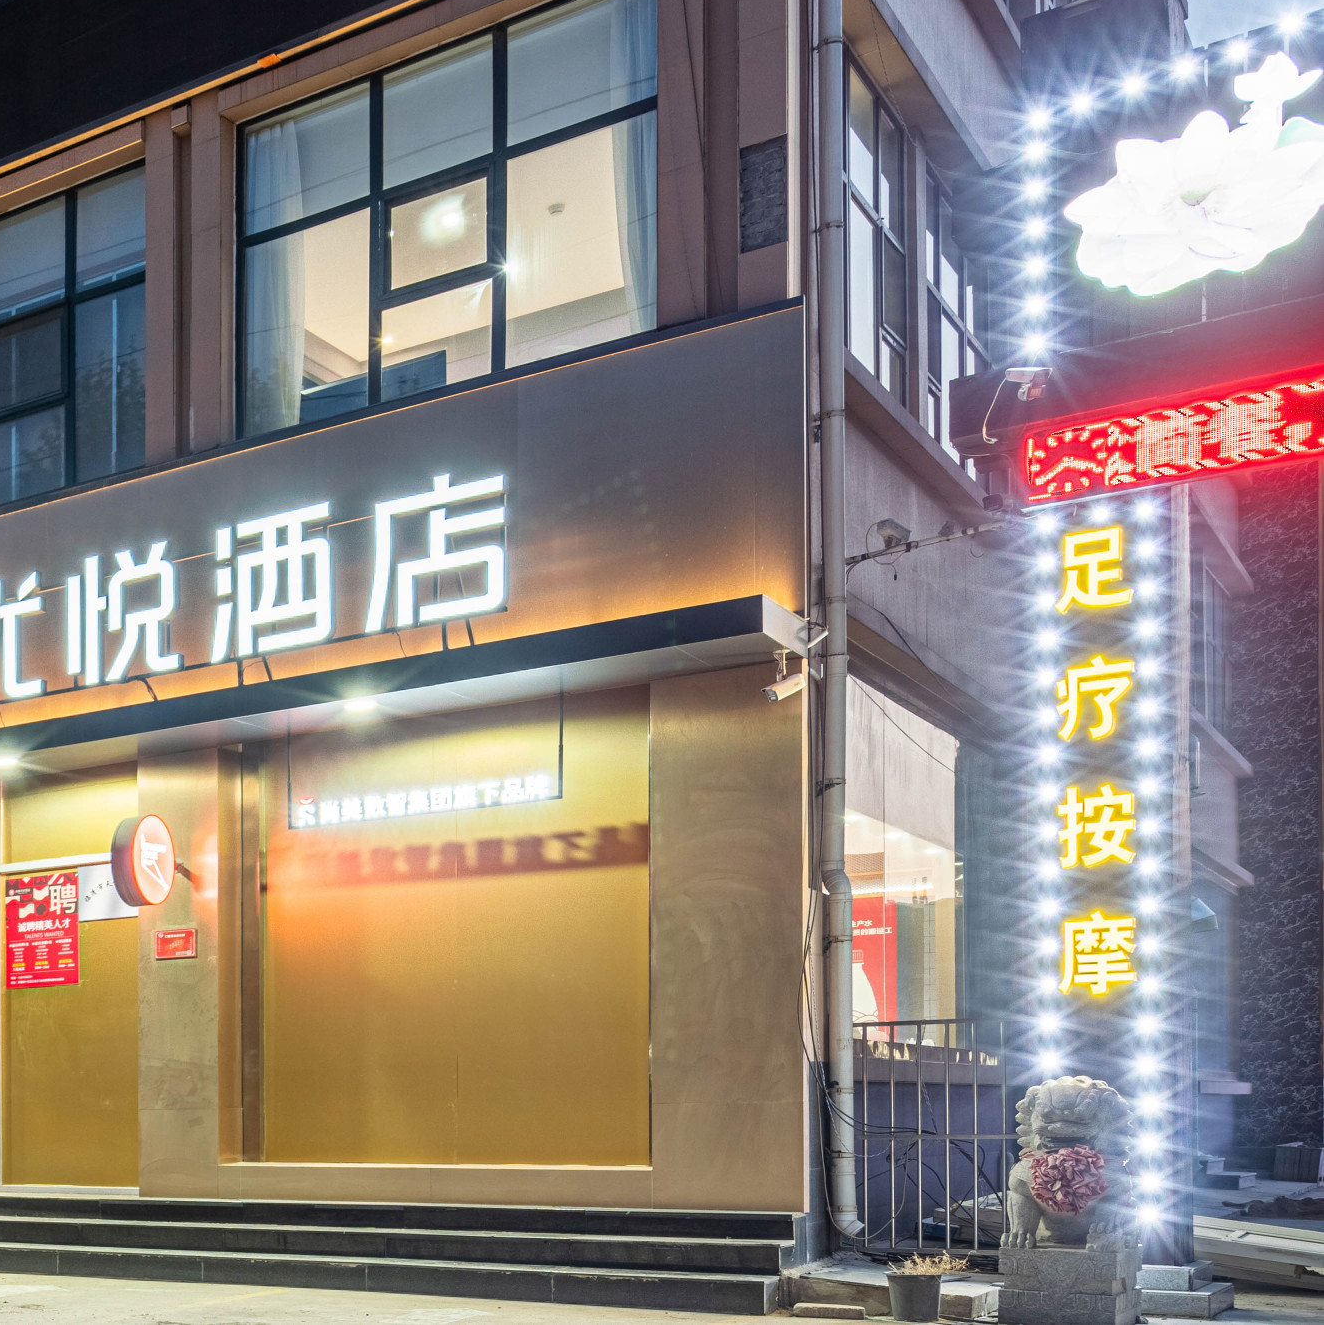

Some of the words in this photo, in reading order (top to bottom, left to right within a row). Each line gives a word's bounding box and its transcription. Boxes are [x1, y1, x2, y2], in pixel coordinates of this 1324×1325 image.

[1054, 525, 1137, 997] 足疗按摩
[49, 882, 78, 915] 聘
[17, 917, 71, 933] 诚聘精英人才
[43, 930, 65, 938] WANTED
